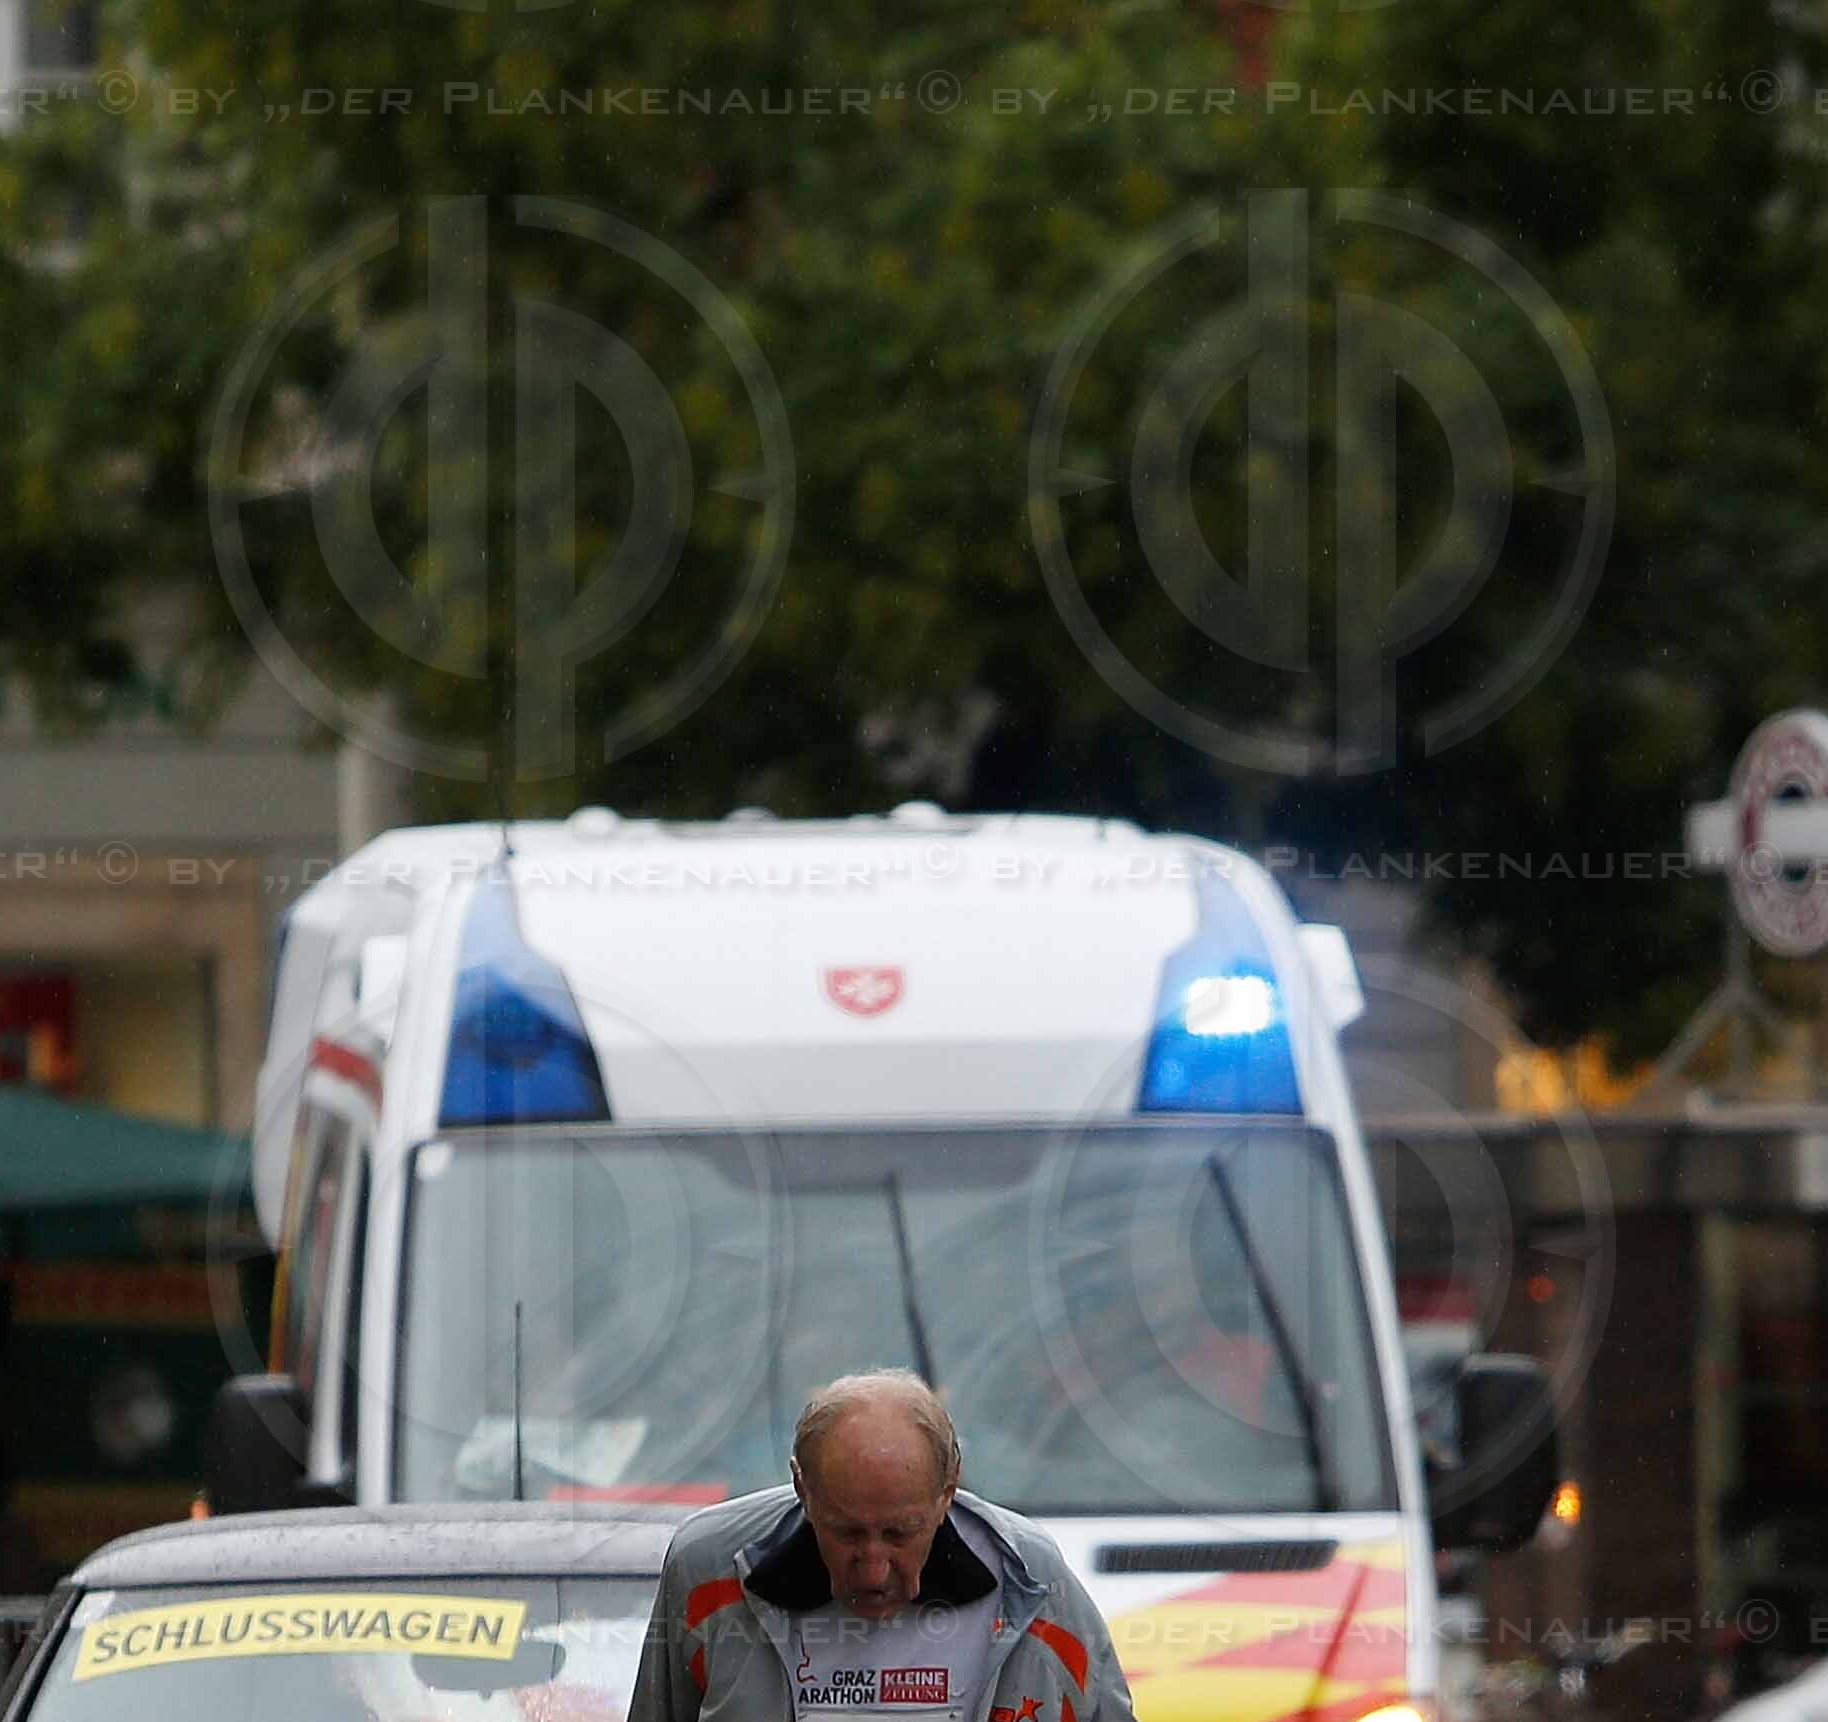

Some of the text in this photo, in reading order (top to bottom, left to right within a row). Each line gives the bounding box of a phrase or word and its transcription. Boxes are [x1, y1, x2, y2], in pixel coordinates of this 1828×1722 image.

[91, 1607, 505, 1664] SCHLUSSWAGEN
[832, 1670, 876, 1686] GRAZ
[884, 1671, 946, 1687] KLEINE
[798, 1687, 876, 1705] ARATHON
